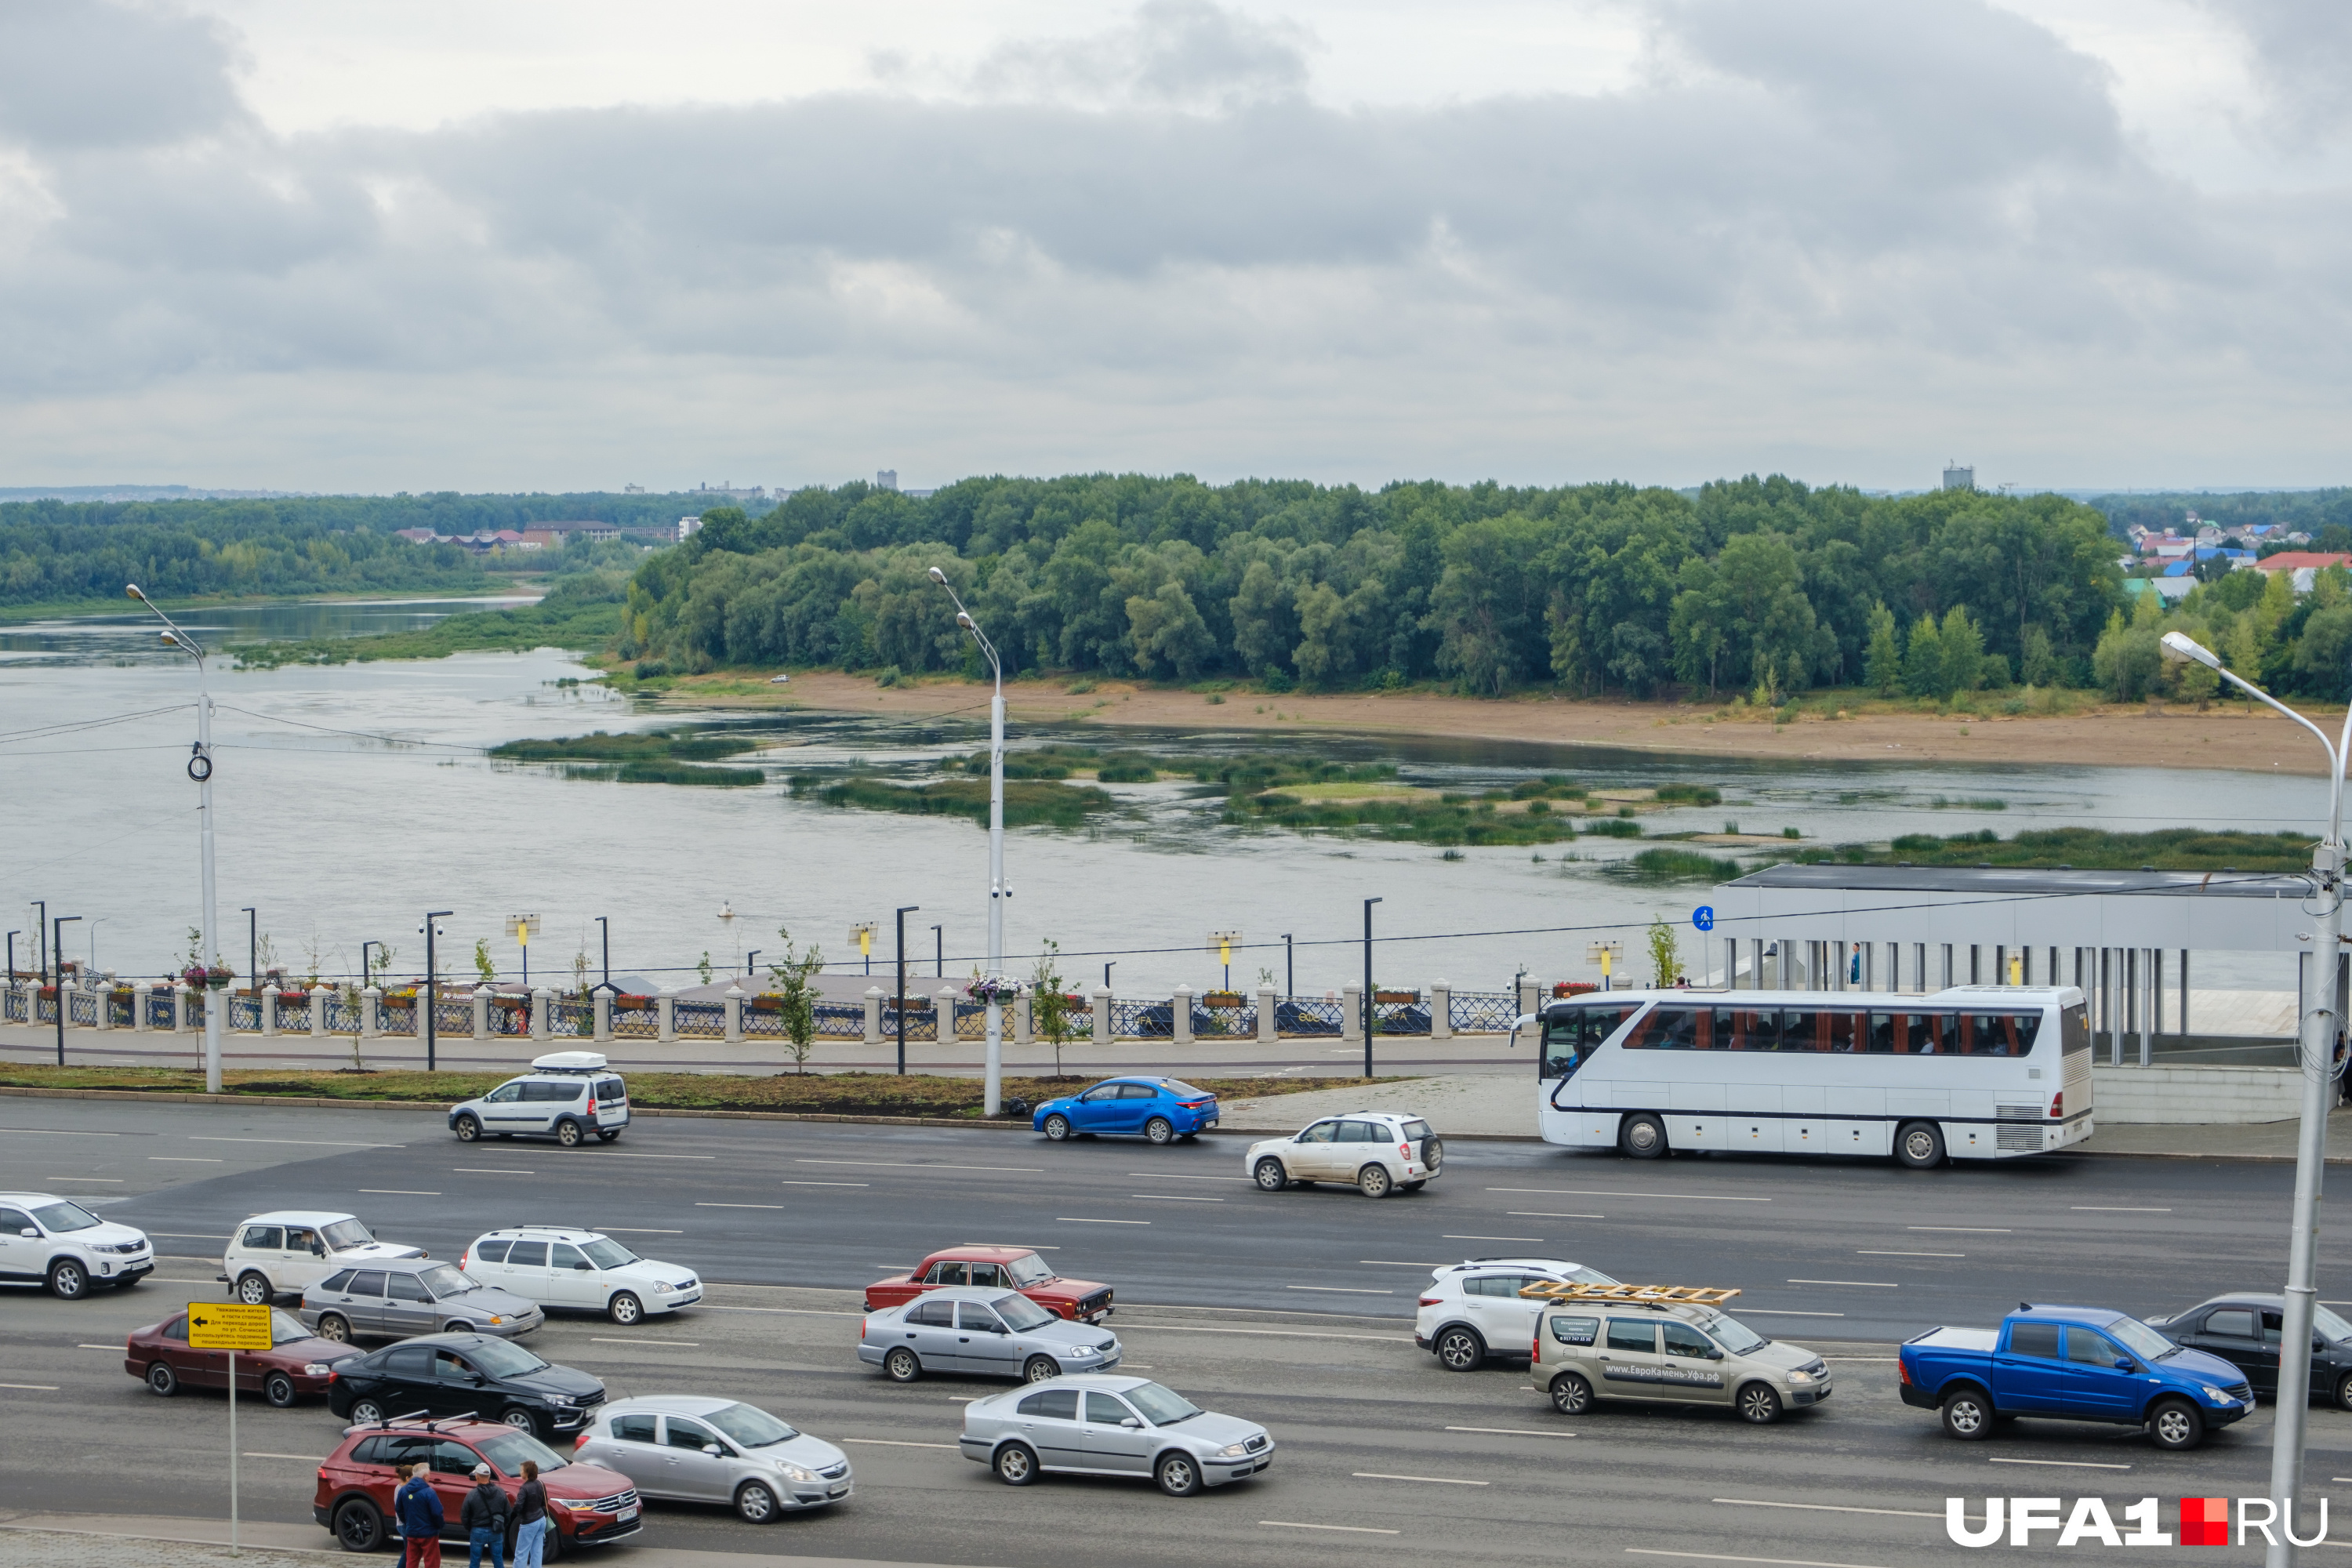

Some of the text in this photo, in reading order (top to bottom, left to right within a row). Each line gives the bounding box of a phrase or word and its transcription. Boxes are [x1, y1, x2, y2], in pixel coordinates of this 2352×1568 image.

[1134, 1016, 1153, 1025] UFA
[1387, 1011, 1408, 1021] UFA
[1606, 1365, 1719, 1382] www.ЕвроКамень-Уфа.рф
